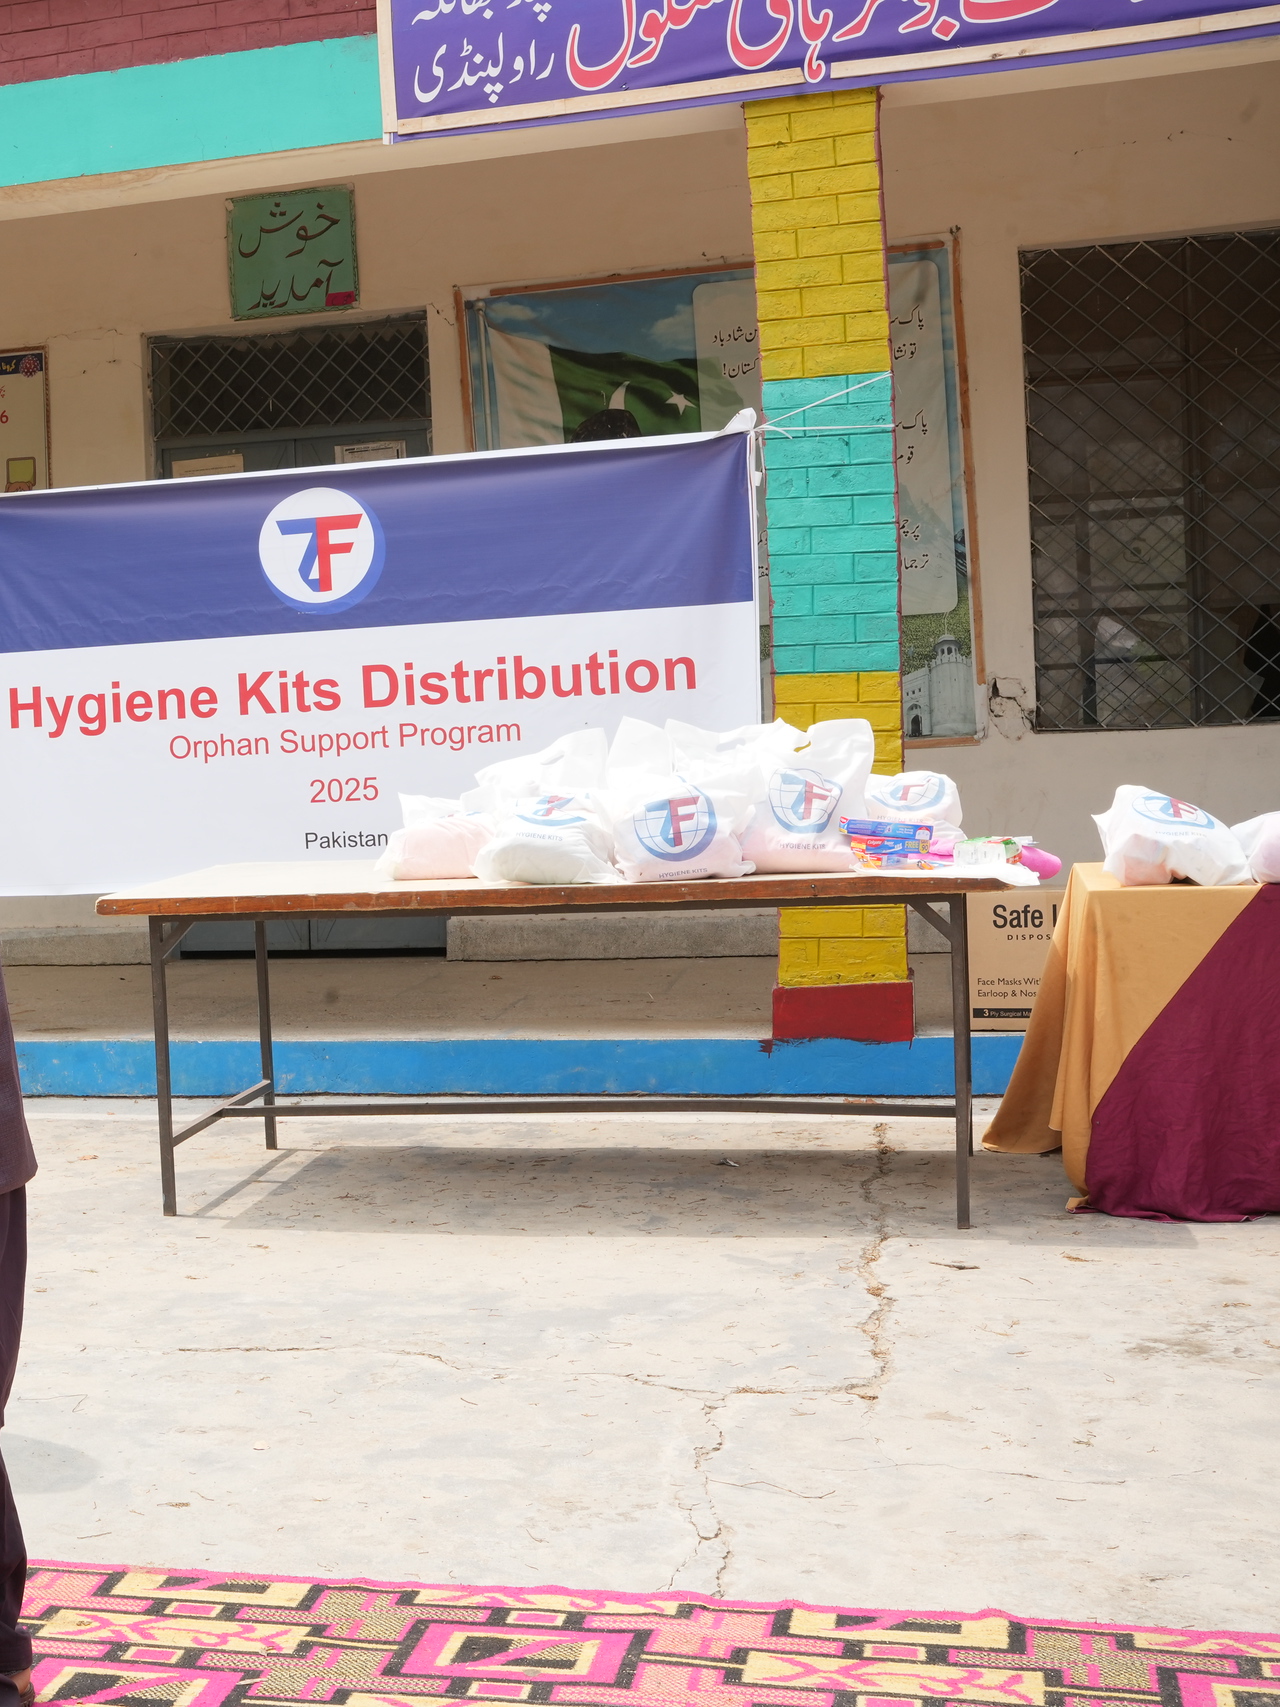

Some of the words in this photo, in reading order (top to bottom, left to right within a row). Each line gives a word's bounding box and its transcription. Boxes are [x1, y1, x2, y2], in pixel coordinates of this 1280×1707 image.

[414, 32, 555, 103] راولپنڈی
[238, 202, 340, 258] خوش
[898, 305, 924, 330] پاک
[0, 410, 9, 424] 6
[902, 409, 928, 435] پاک
[8, 681, 218, 739] Hygiene
[237, 670, 341, 717] Kits
[362, 649, 697, 709] Distribution
[169, 733, 269, 763] Orphan
[280, 725, 389, 758] Support
[399, 721, 521, 751] Program
[309, 777, 379, 804] 2025
[304, 830, 388, 850] Pakistan
[547, 834, 564, 842] KITS
[658, 871, 686, 879] HYGIENE
[687, 867, 708, 876] KITS
[992, 904, 1044, 928] Safe
[977, 977, 995, 986] Face
[998, 977, 1022, 986] Masks
[977, 989, 1009, 999] Earloop
[1011, 990, 1017, 998] &
[983, 1009, 989, 1017] 3
[990, 1010, 999, 1018] Ply
[1000, 1010, 1022, 1018] Surgical
